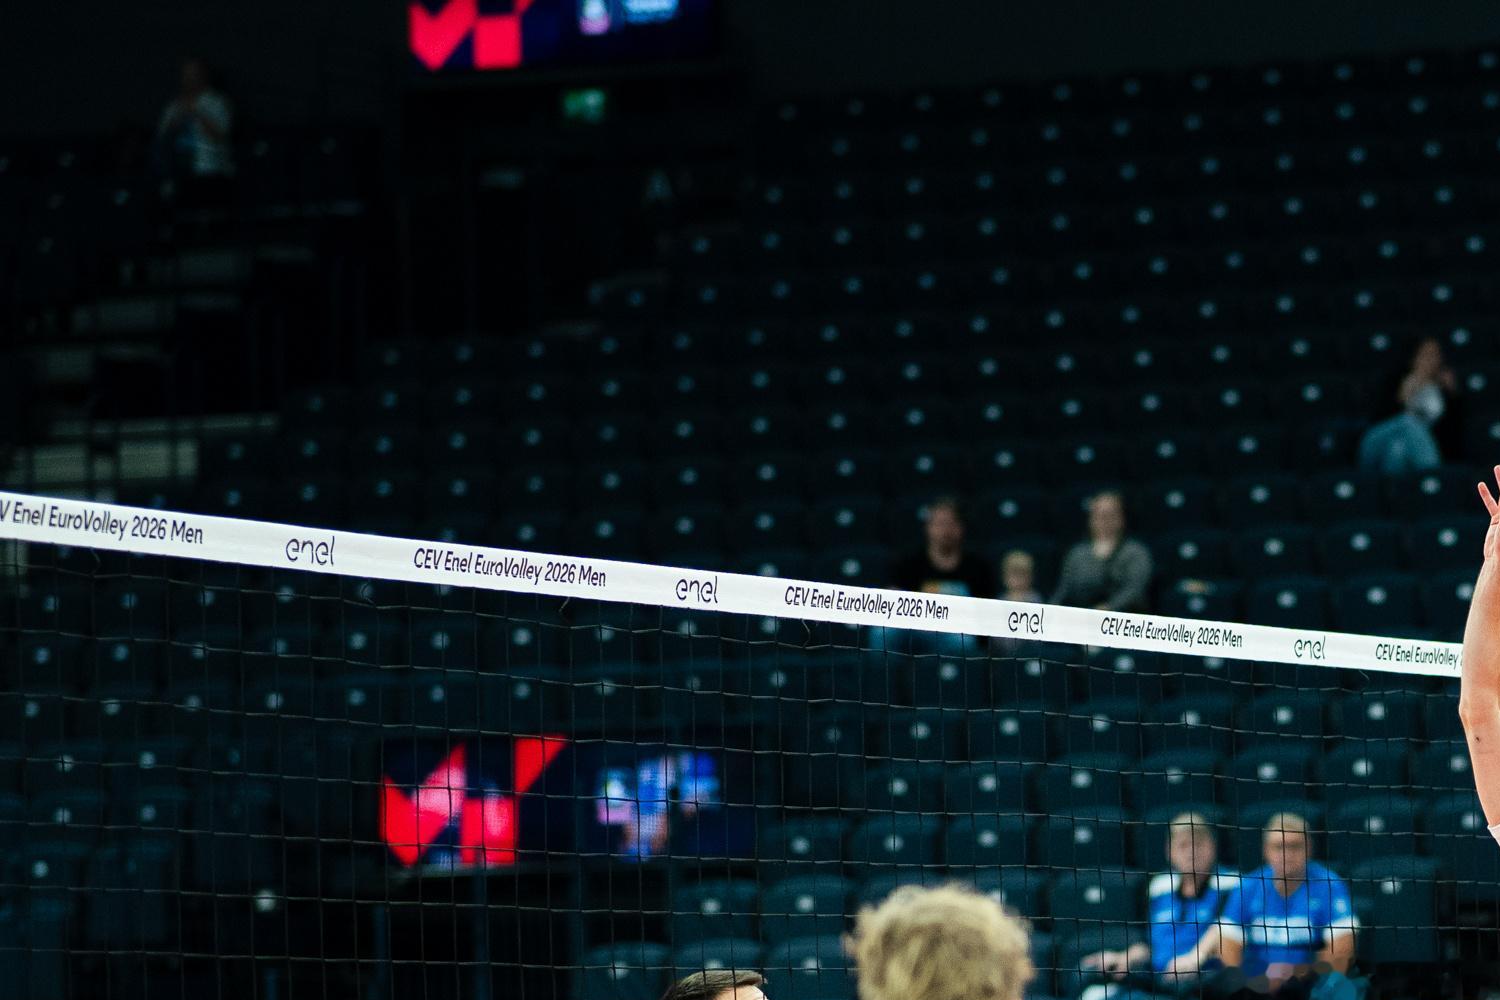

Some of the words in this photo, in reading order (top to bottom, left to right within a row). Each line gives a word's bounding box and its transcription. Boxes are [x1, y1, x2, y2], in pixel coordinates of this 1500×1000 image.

[13, 501, 46, 527] Enel
[49, 505, 128, 541] EuroVolley
[131, 515, 168, 540] 2026
[170, 520, 204, 545] Men
[286, 535, 335, 567] enel
[413, 547, 443, 571] CEV
[444, 550, 474, 574] Enel
[474, 553, 543, 586] EuroVolley
[544, 561, 578, 585] 2026
[578, 564, 607, 587] Men
[676, 575, 719, 604] enel
[784, 585, 810, 608] CEV
[810, 588, 835, 610] Enel
[836, 591, 895, 620] EuroVolley
[896, 596, 923, 619] 2026
[924, 599, 949, 621] Men
[1007, 607, 1045, 635] enel
[1100, 616, 1124, 637] CEV
[1123, 619, 1144, 639] Enel
[1145, 621, 1197, 648] EuroVolley
[1197, 626, 1221, 647] 2026
[1221, 628, 1243, 648] Men
[1293, 634, 1327, 661] enel
[1375, 642, 1395, 661] CEV
[1395, 644, 1414, 663] Enel
[1414, 646, 1459, 671] EuroVolley
